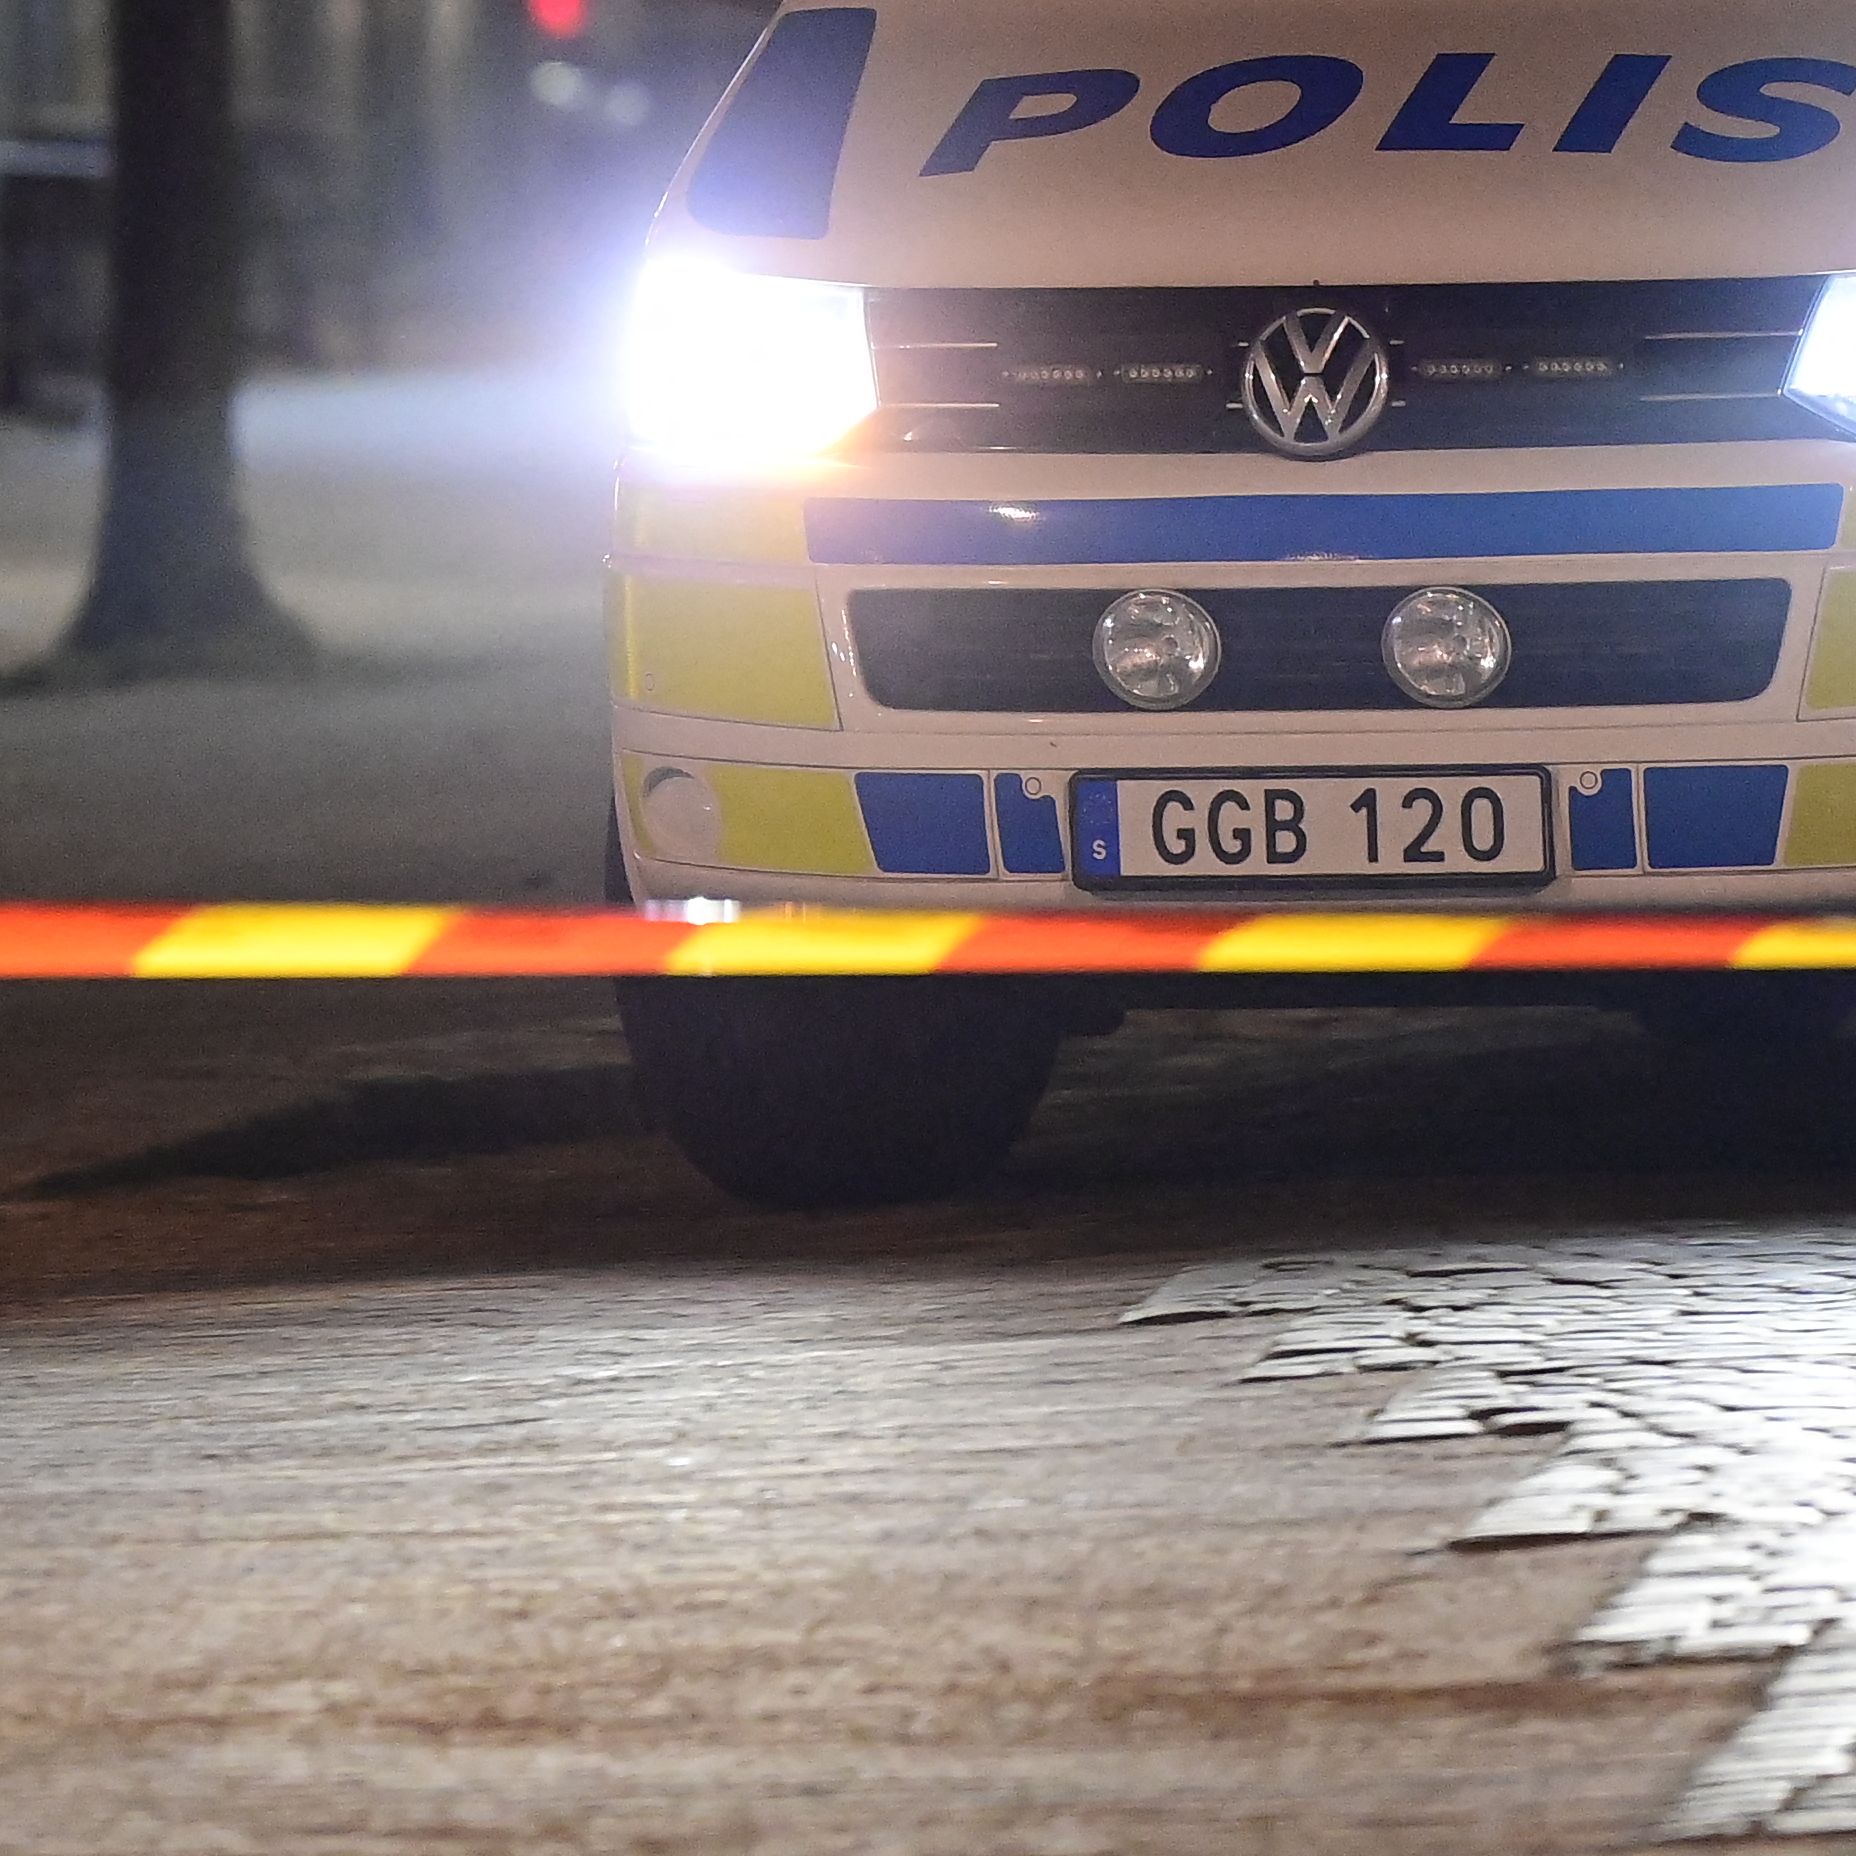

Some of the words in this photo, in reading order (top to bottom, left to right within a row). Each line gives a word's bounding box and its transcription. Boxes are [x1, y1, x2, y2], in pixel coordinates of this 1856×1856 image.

[1092, 839, 1107, 860] S
[1151, 788, 1308, 865] GGB
[1349, 785, 1505, 863] 120
